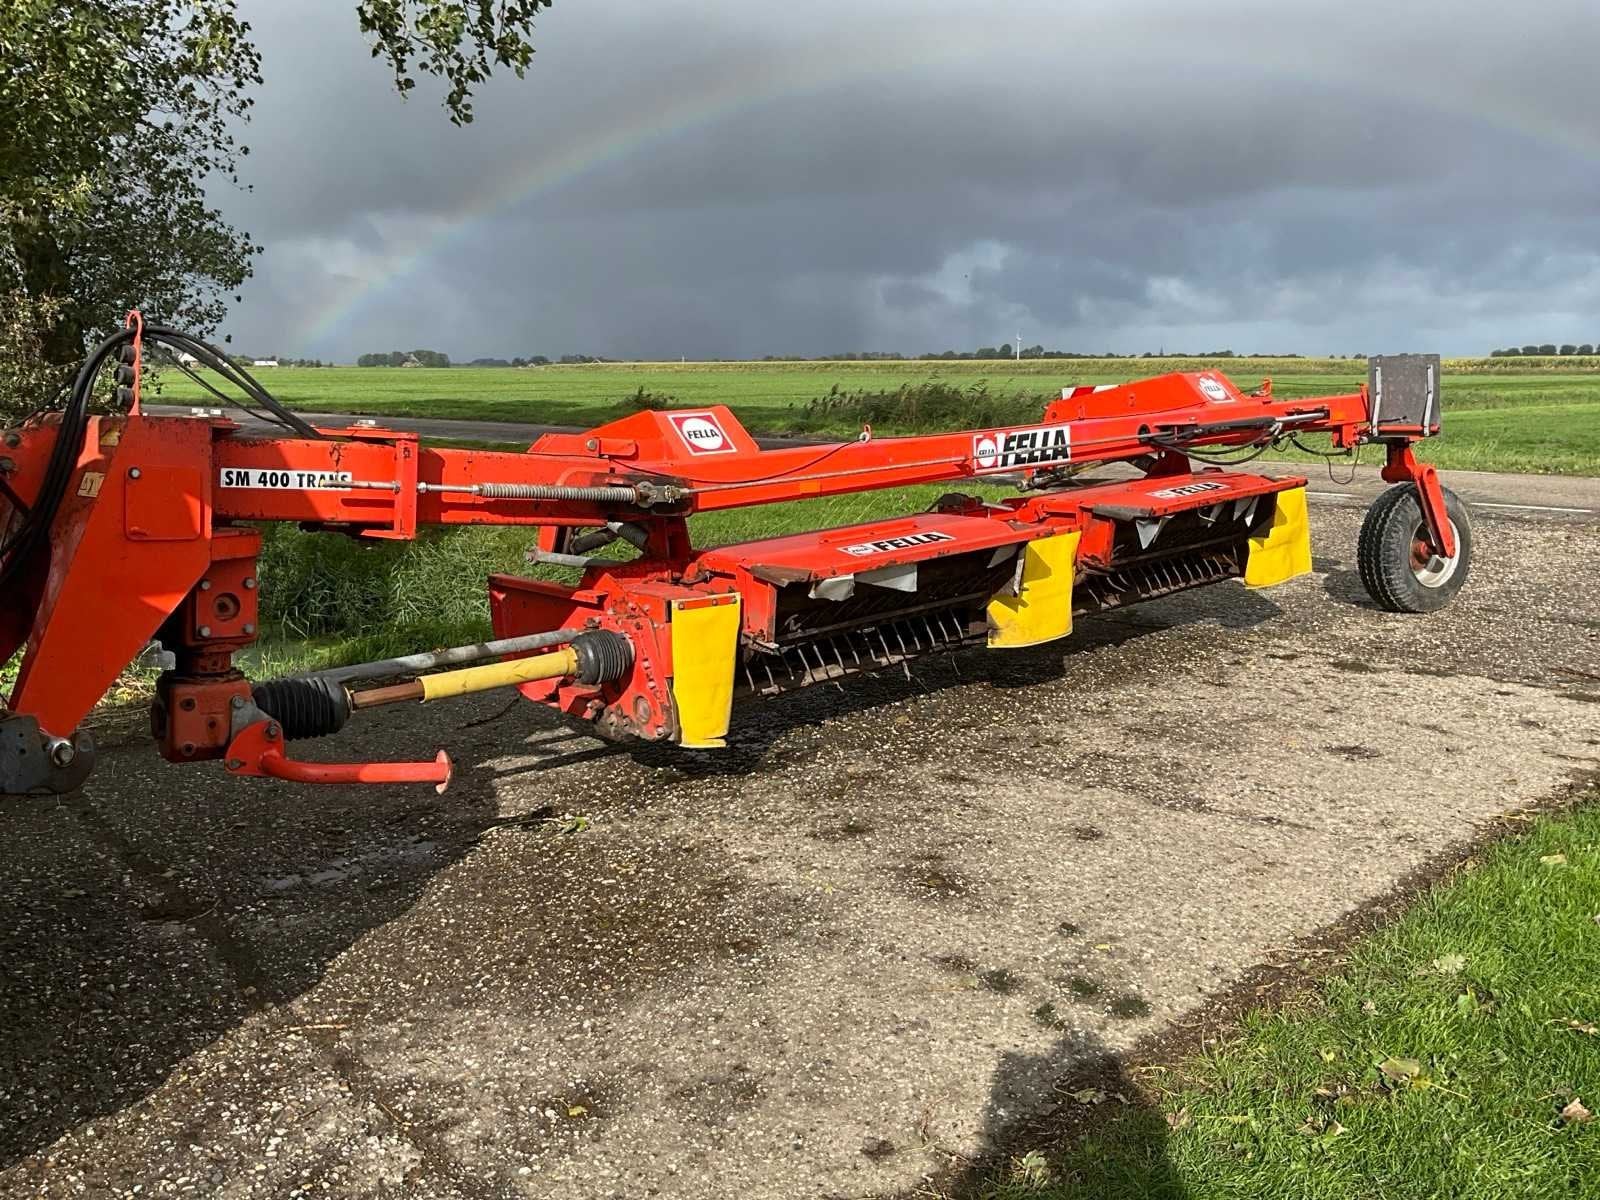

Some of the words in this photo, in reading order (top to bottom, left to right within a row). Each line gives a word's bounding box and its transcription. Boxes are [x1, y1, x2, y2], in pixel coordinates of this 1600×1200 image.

[686, 428, 720, 440] FELLA
[1001, 429, 1069, 468] FELLA
[224, 470, 251, 486] SM
[258, 471, 290, 488] 400
[1169, 483, 1224, 496] FELLA
[872, 533, 953, 552] FELLA
